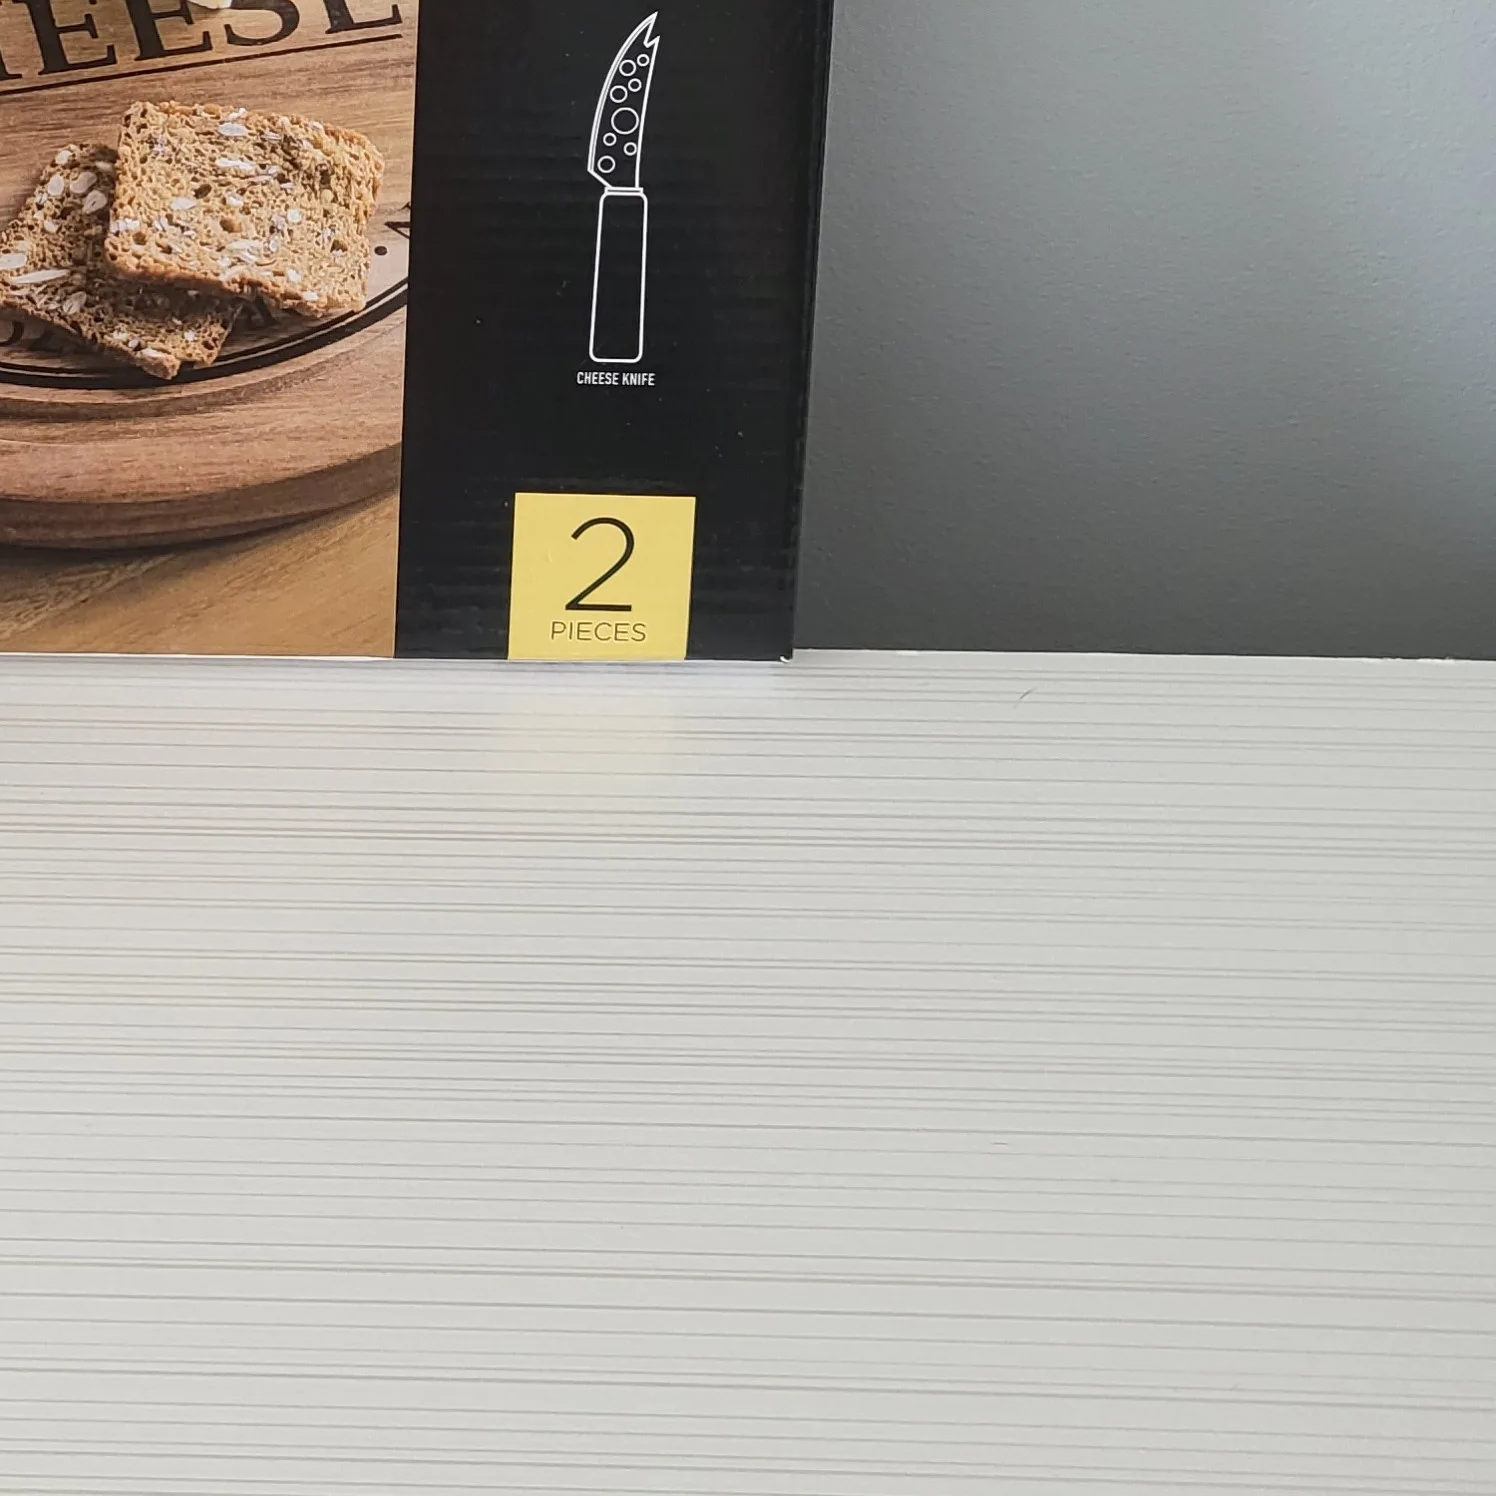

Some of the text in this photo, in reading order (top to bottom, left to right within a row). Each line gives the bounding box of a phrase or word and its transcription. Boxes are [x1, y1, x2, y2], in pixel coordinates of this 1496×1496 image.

[576, 371, 656, 386] CHEESE KNIFE
[565, 517, 635, 612] 2
[550, 621, 647, 642] PIECES
